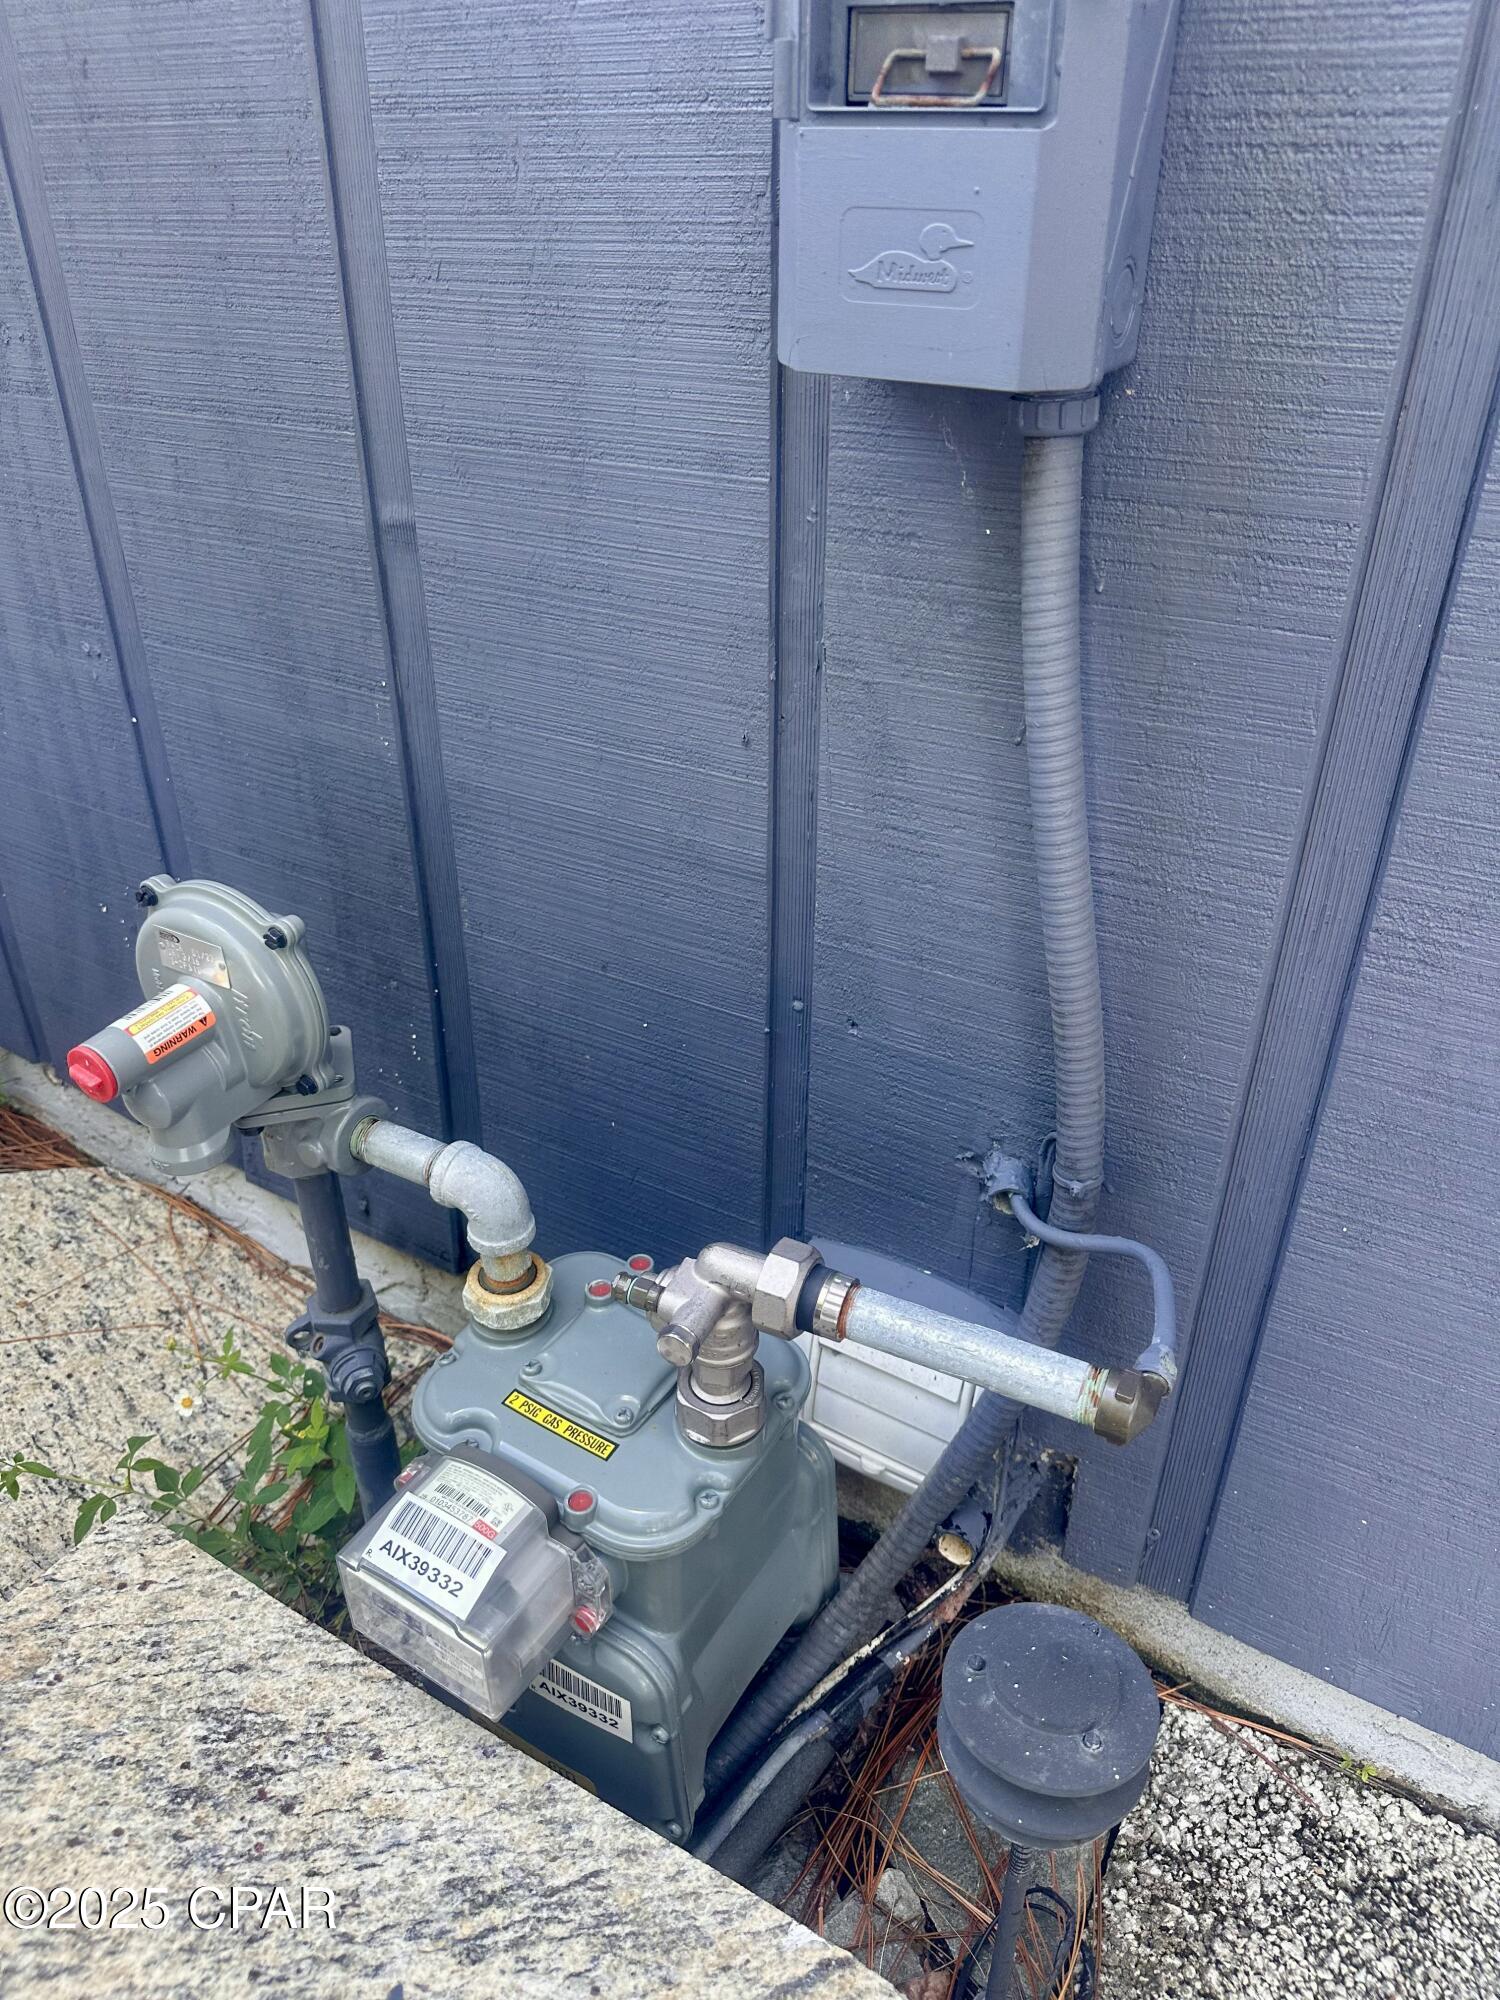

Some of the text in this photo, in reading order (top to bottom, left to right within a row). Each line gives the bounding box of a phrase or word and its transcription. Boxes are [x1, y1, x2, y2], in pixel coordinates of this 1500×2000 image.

[878, 260, 949, 286] Midwest
[153, 1026, 197, 1057] WARNING
[509, 1395, 612, 1455] 2 PSIG GAS PRESSURE
[474, 1520, 497, 1540] 500G
[379, 1539, 464, 1598] AIX39332
[539, 1681, 620, 1729] AIX39332
